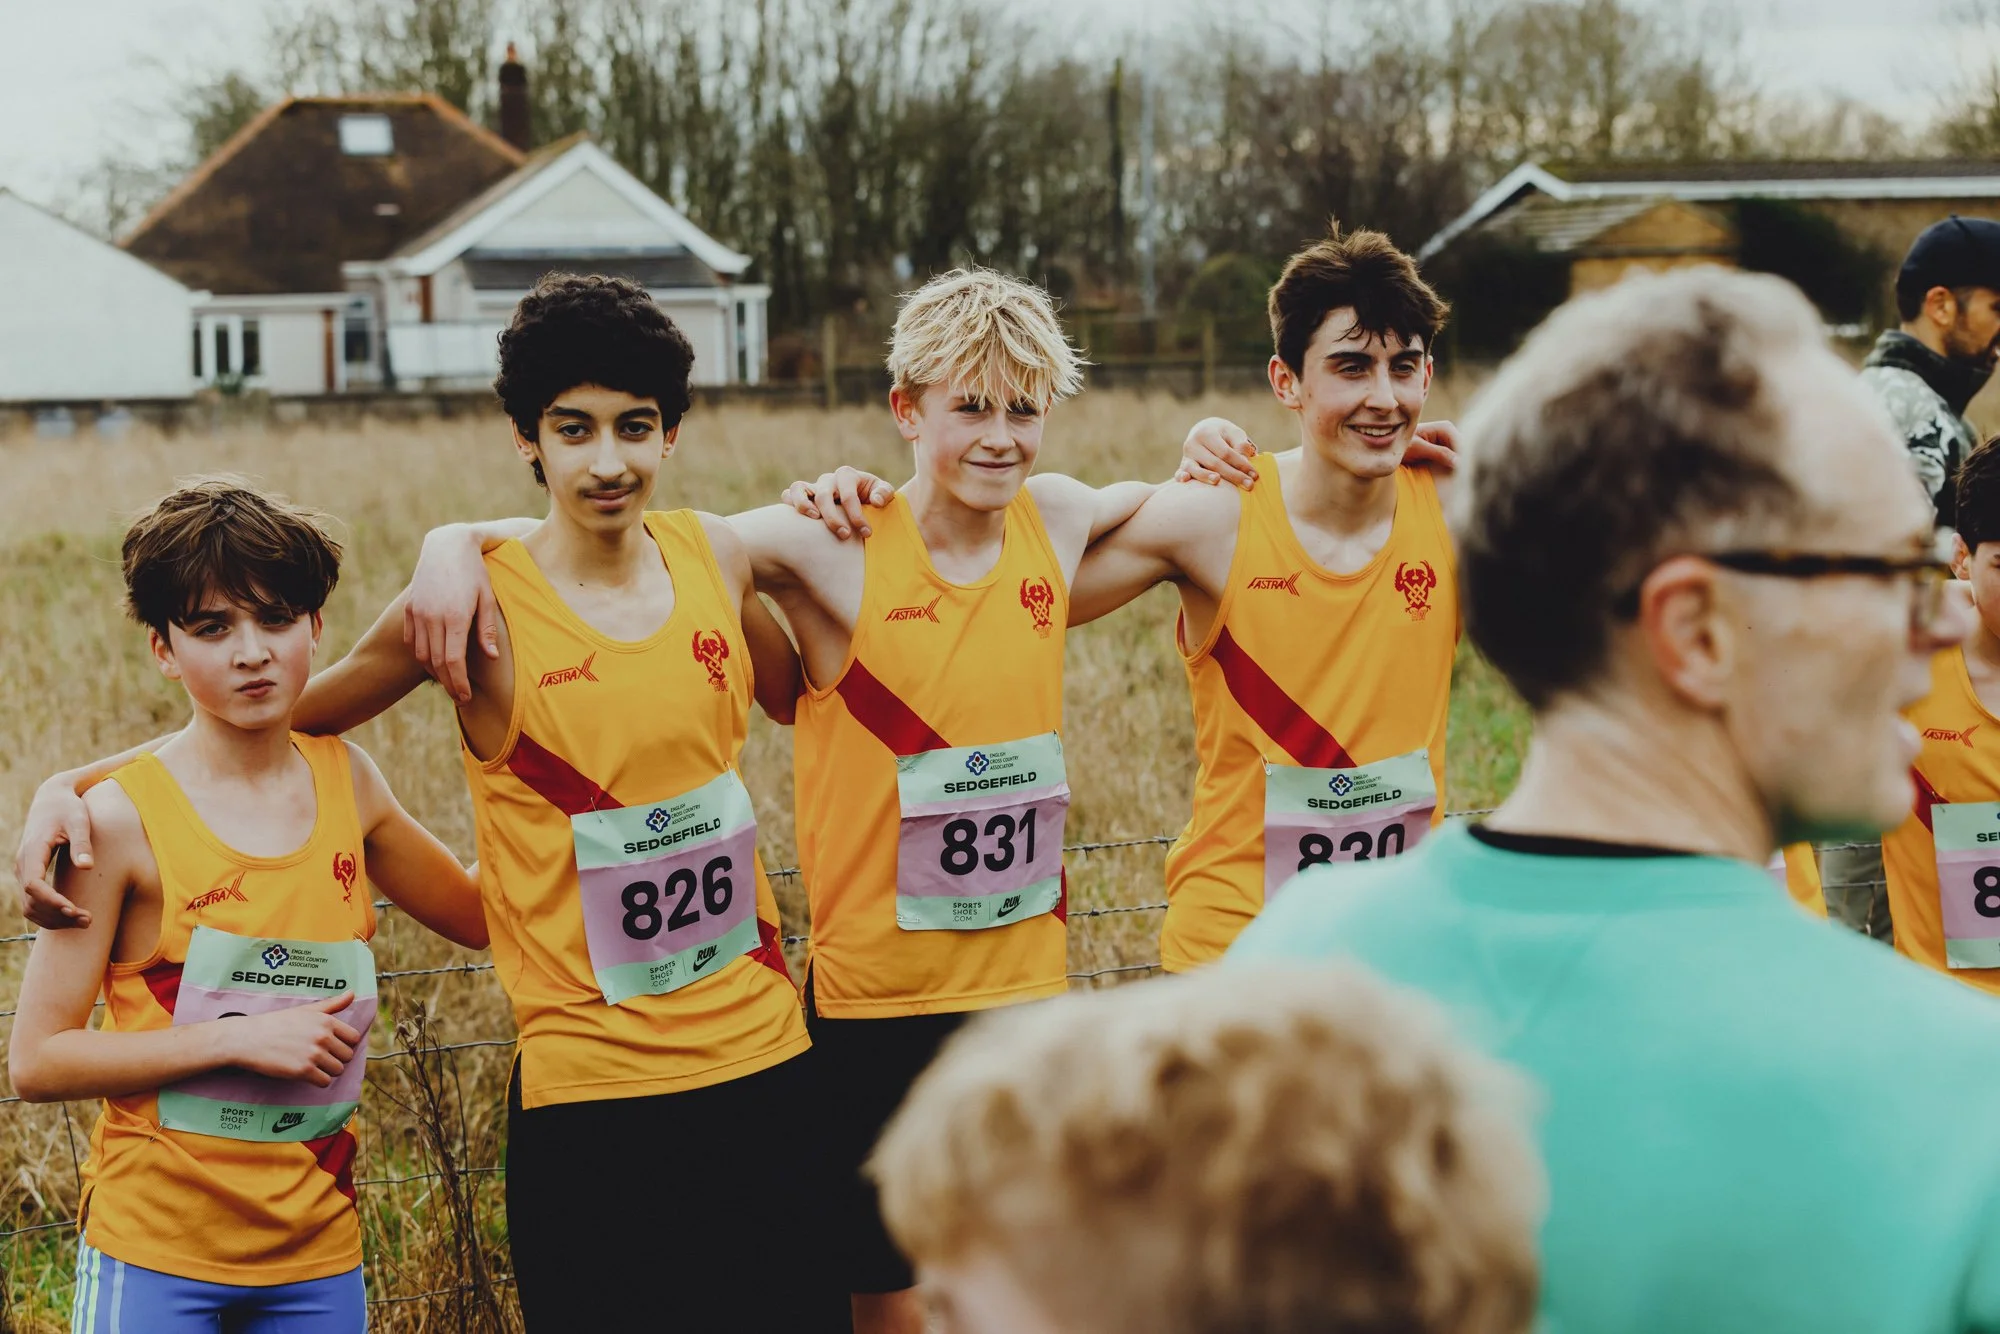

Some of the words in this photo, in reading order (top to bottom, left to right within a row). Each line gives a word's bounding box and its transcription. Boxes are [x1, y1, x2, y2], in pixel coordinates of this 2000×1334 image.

[990, 762, 1014, 770] ASSOCIATION
[1003, 755, 1019, 763] COUNTRY
[944, 771, 1037, 793] SEDGEFIELD
[1307, 789, 1402, 809] SEDGEFIELD
[623, 817, 721, 854] SEDGEFIELD
[940, 807, 1037, 876] 831
[621, 855, 733, 940] 826
[1003, 894, 1021, 909] RUN
[696, 944, 717, 961] RUN
[650, 960, 676, 974] SPORTS
[231, 971, 347, 990] SEDGEFIELD
[650, 968, 673, 981] SHOES
[651, 977, 671, 988] .COM
[219, 1114, 249, 1124] SHOES
[221, 1107, 255, 1117] SPORTS
[279, 1112, 305, 1124] RUN
[218, 1122, 241, 1131] .COM
